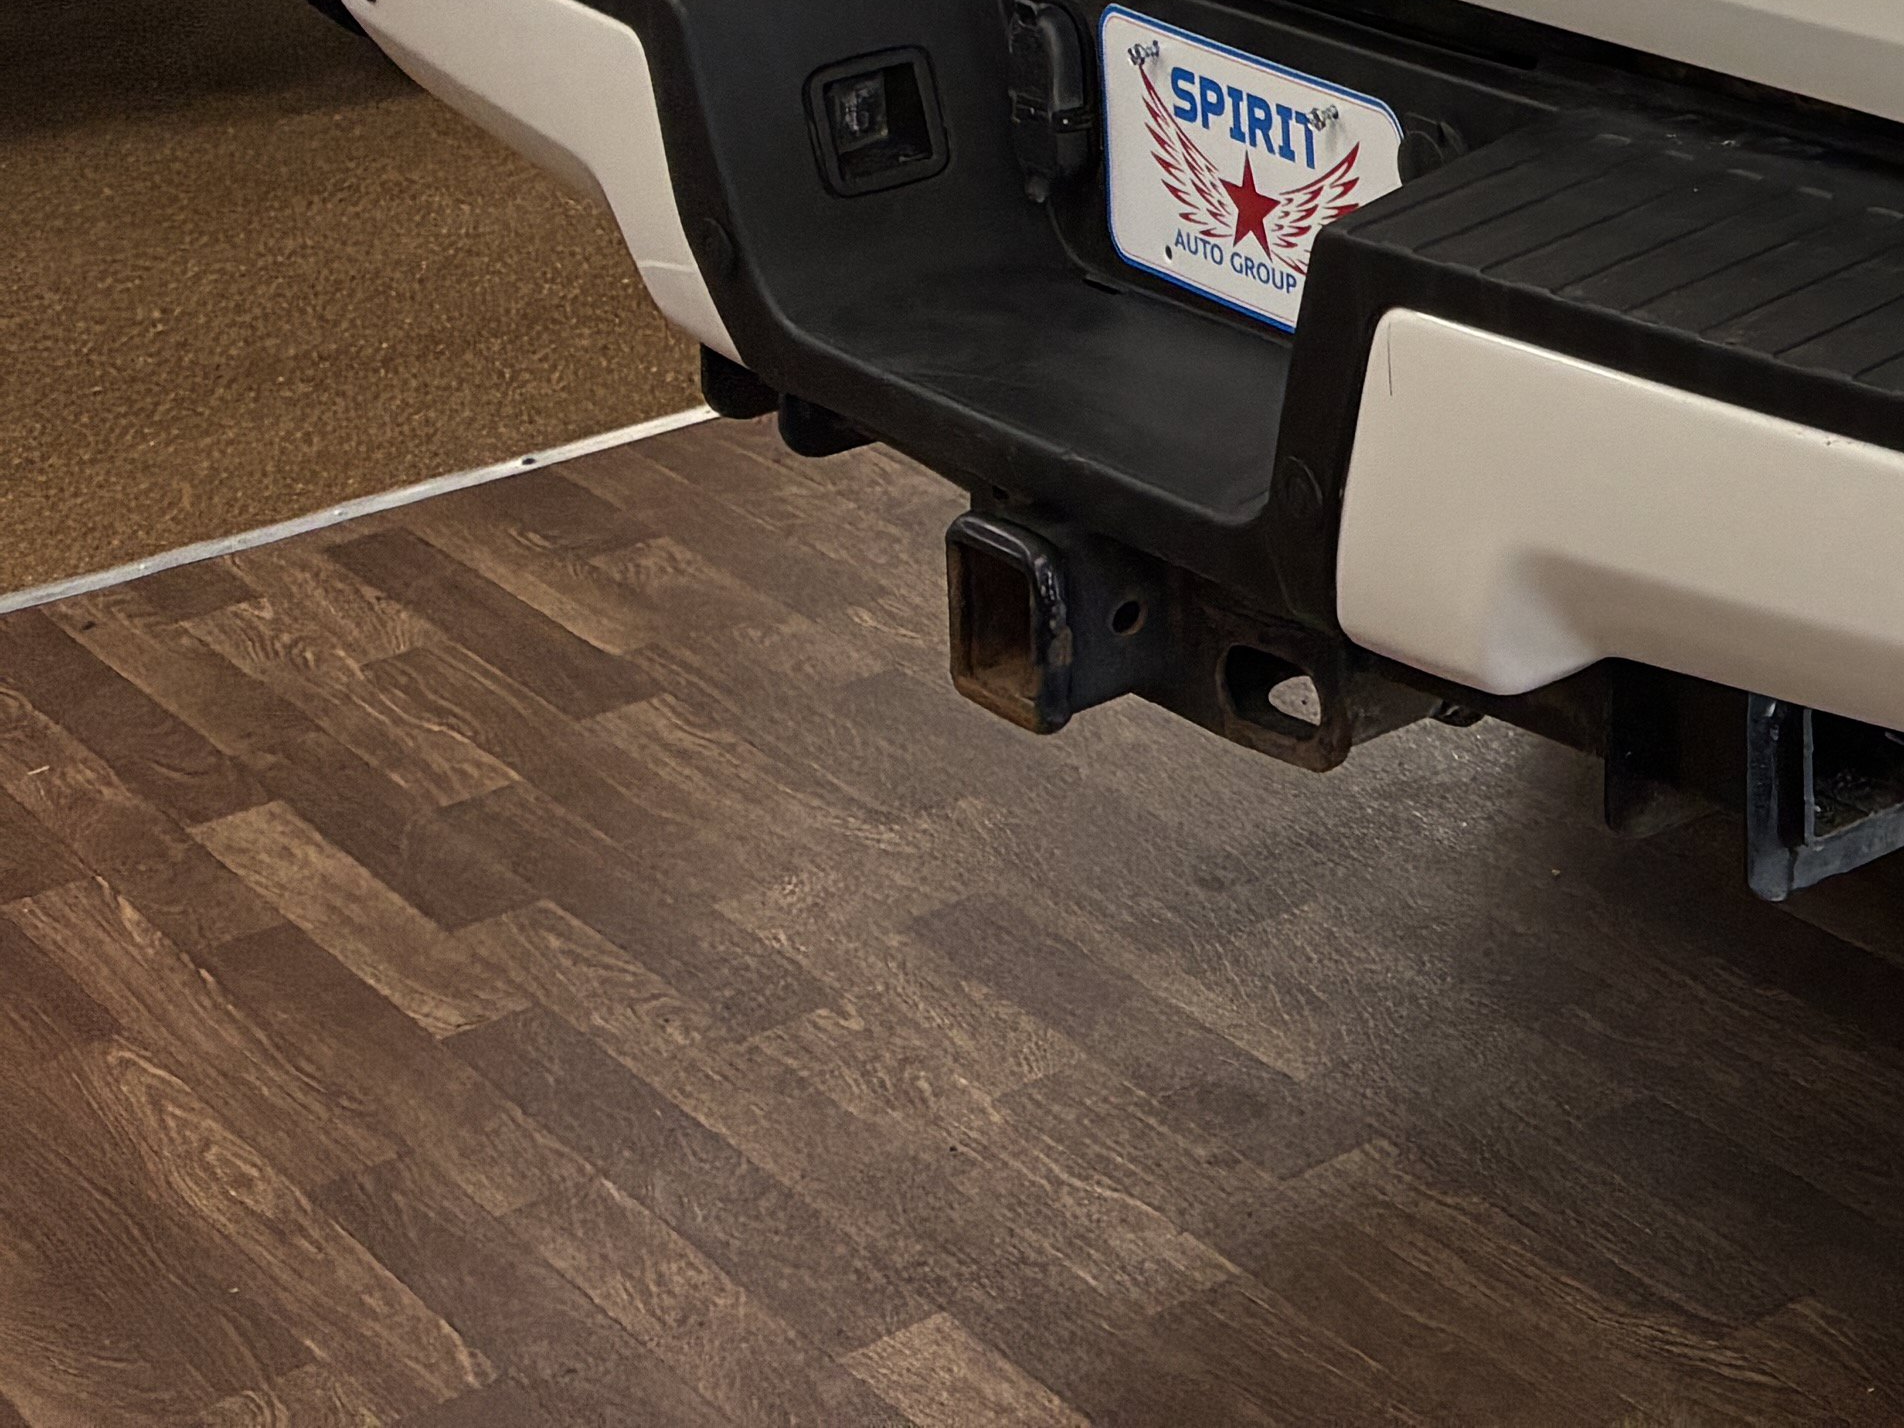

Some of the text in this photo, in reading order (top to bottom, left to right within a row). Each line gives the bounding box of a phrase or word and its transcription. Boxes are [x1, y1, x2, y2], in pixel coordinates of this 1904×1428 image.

[1171, 67, 1316, 169] SPIRIT
[1174, 228, 1298, 294] AUTO GROUP
